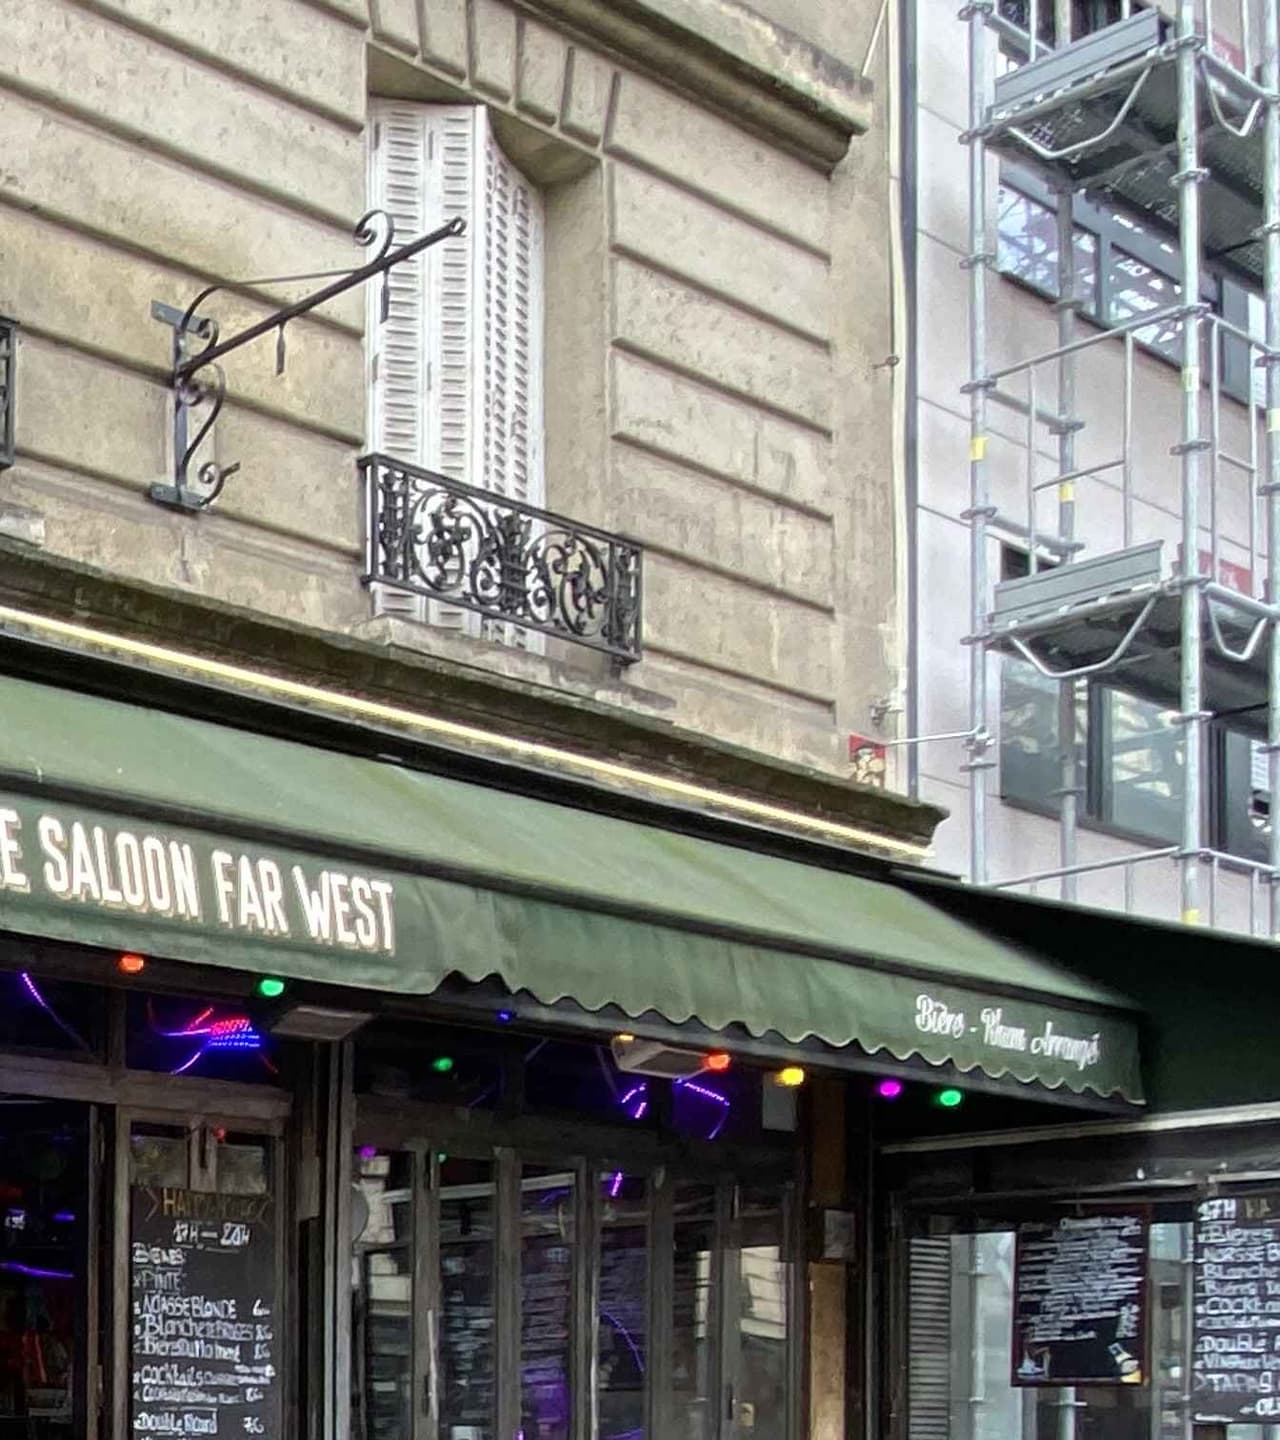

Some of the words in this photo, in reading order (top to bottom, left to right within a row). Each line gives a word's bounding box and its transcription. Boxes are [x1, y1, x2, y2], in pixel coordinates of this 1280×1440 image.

[38, 814, 203, 923] SALOON
[211, 849, 291, 937] FAR
[292, 864, 396, 957] WEST
